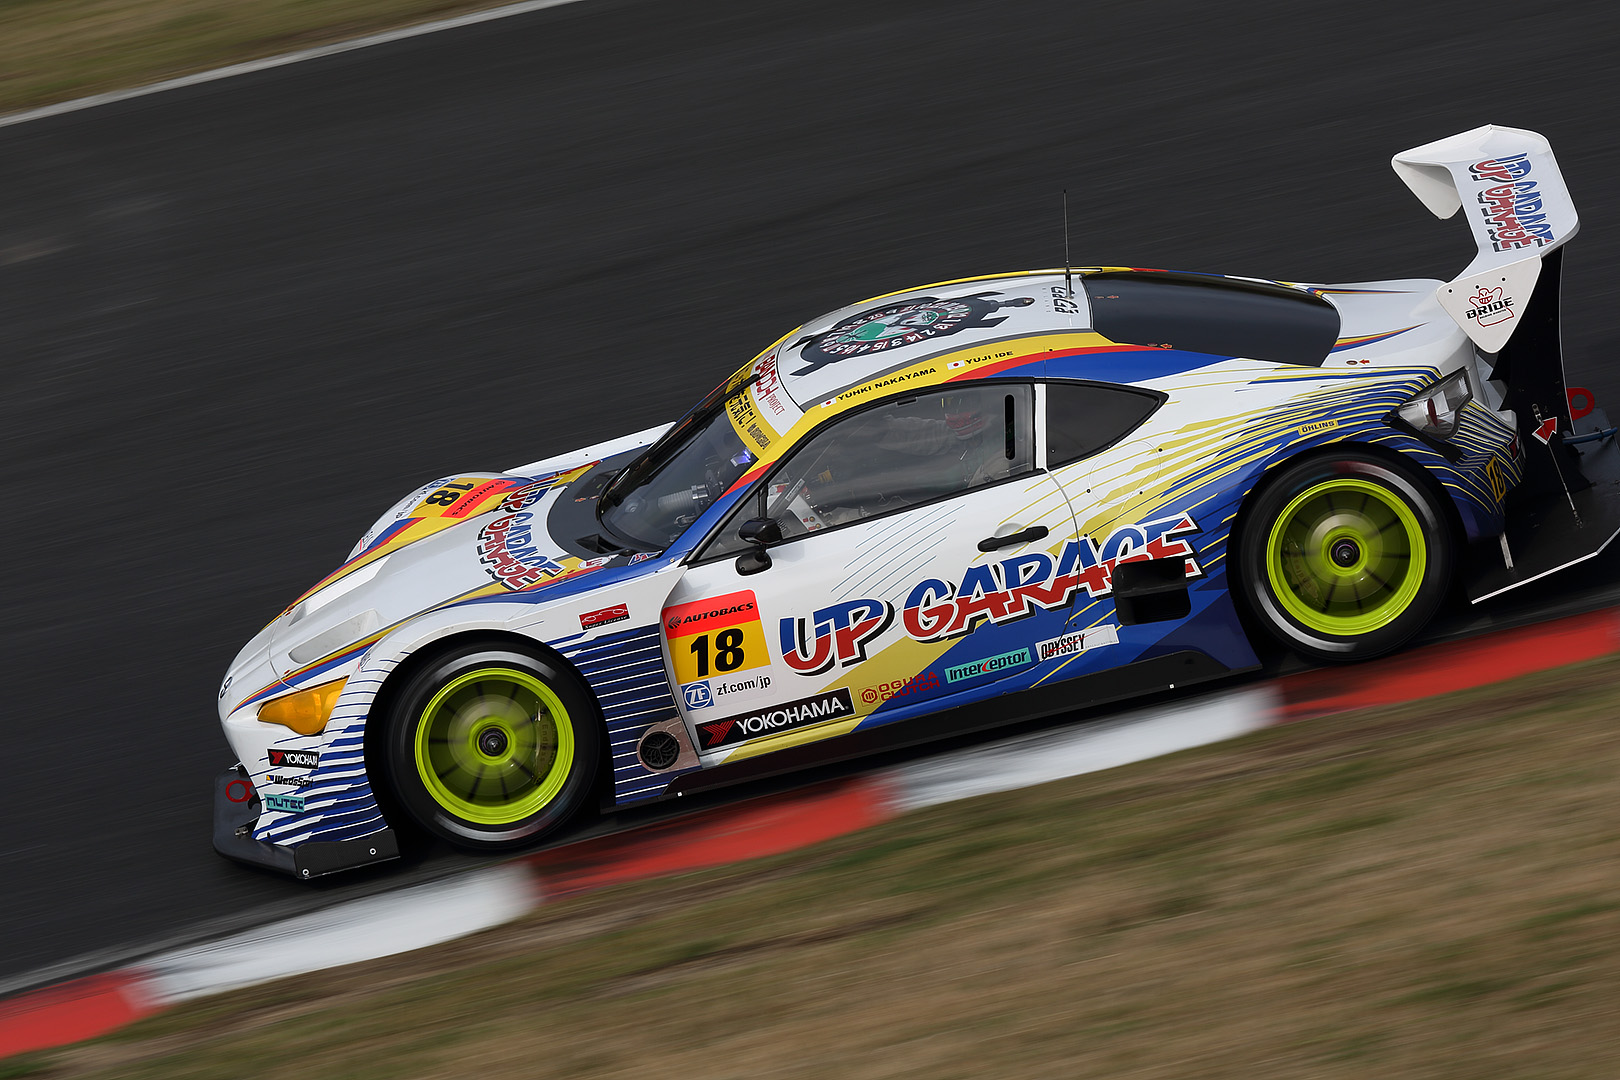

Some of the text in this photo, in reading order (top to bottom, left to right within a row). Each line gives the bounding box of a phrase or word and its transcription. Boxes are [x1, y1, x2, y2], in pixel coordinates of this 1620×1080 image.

[1468, 152, 1532, 182] UP
[1477, 181, 1554, 252] GARAGE
[1465, 297, 1514, 319] BRIDE
[872, 340, 888, 349] 15
[906, 333, 923, 342] 14
[965, 354, 992, 365] YUJI
[837, 367, 936, 401] YUHKI NAKAYAMA
[1302, 421, 1335, 433] ÖHLINS
[425, 481, 474, 507] 18
[476, 477, 566, 591] UP GARAGE
[683, 602, 754, 624] AUTOBACS
[779, 599, 895, 676] UP
[1041, 633, 1086, 660] ODYSSEY
[690, 628, 745, 678] 18
[684, 676, 772, 709] ZF zf.com/jp
[878, 672, 938, 693] OGURA
[880, 681, 940, 701] CLUTCH
[736, 696, 846, 735] YOKOHAMA
